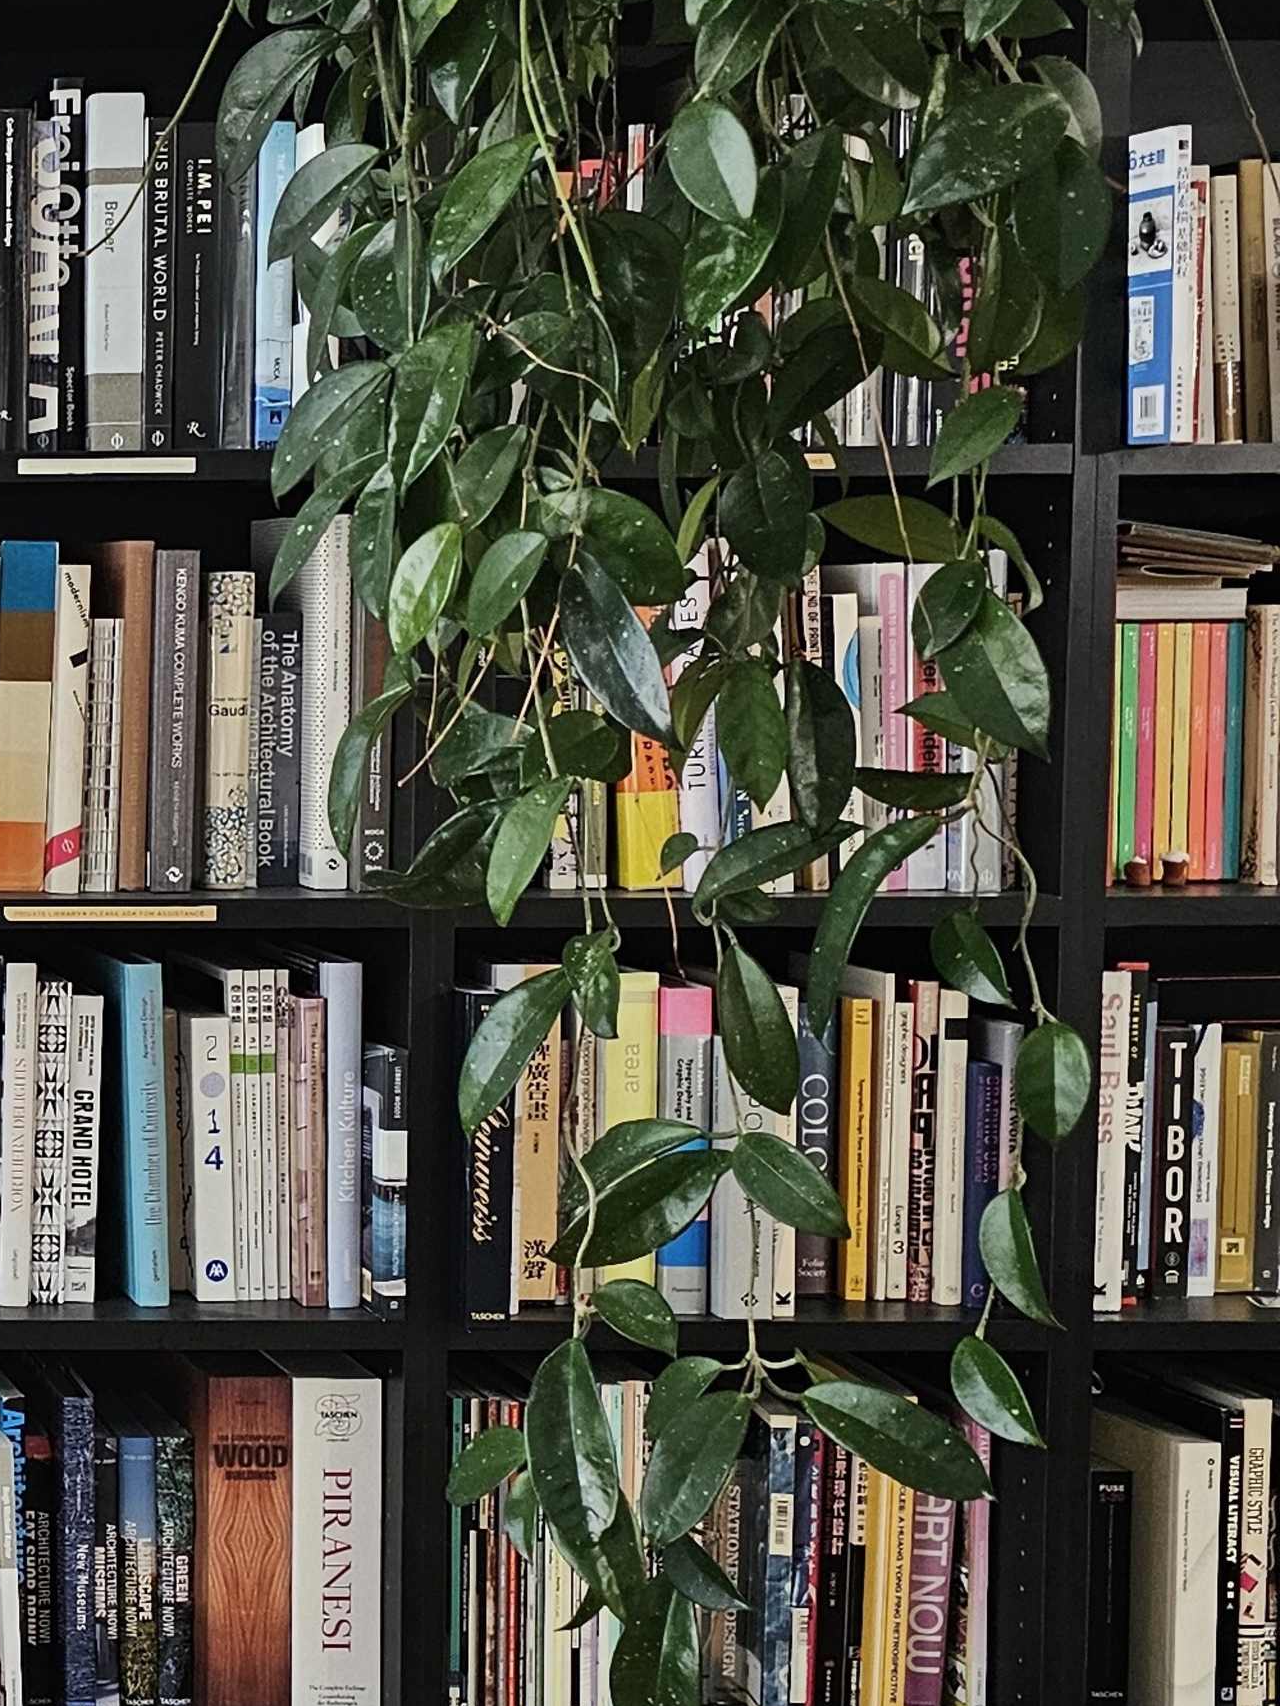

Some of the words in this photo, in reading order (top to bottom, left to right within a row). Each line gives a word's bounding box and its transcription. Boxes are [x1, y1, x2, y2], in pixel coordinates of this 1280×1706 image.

[153, 178, 169, 249] BRUTAL
[153, 254, 169, 322] WORLD
[154, 331, 164, 360] PETER
[153, 363, 164, 415] CHADWICK
[175, 568, 187, 611] KENGO
[807, 590, 818, 607] END
[174, 614, 186, 650] KUMA
[807, 611, 818, 622] OF
[262, 630, 278, 649] of
[282, 630, 298, 666] The
[807, 627, 818, 652] PRINT
[172, 652, 184, 718] COMPLETE
[261, 651, 277, 687] the
[277, 670, 297, 757] Anatomy
[171, 722, 183, 768] WORKS
[258, 692, 277, 814] Architectural
[257, 819, 274, 867] Book
[899, 1011, 909, 1041] graphic
[1099, 993, 1124, 1058] Saul
[1131, 994, 1140, 1013] THE
[1130, 1017, 1140, 1043] BEST
[1131, 1046, 1139, 1058] OF
[580, 1034, 593, 1075] Mapping
[624, 1041, 641, 1094] area
[674, 1058, 685, 1093] Graphic
[898, 1044, 909, 1084] designers
[338, 1071, 356, 1132] Kulture
[580, 1077, 592, 1109] graphic
[684, 1058, 695, 1102] Typography
[72, 1089, 95, 1149] GRAND
[674, 1095, 685, 1119] Design
[684, 1104, 694, 1120] and
[1098, 1072, 1121, 1143] Bass
[1164, 1042, 1187, 1243] TIBOR
[71, 1155, 92, 1209] HOTEL
[338, 1136, 356, 1202] Kitchen
[893, 1205, 903, 1234] Europe
[801, 1259, 826, 1268] Folio
[893, 1241, 905, 1254] 3
[798, 1269, 827, 1278] Society
[212, 1444, 288, 1469] WOOD
[1226, 1455, 1241, 1501] VISUAL
[1248, 1447, 1264, 1496] GRAPHIC
[914, 1492, 953, 1566] ART
[1225, 1505, 1240, 1563] LITERACY
[1247, 1500, 1263, 1534] STYLE
[38, 1512, 50, 1605] ARCHITECTURE
[106, 1524, 118, 1607] ARCHITECTURE
[125, 1520, 137, 1609] ARCHITECTURE
[162, 1520, 174, 1609] ARCHITECTURE
[322, 1468, 352, 1652] PIRANESI
[895, 1525, 904, 1563] HUANG
[176, 1555, 188, 1602] GREEN
[894, 1564, 903, 1593] YONG
[75, 1574, 89, 1631] Museums
[106, 1610, 117, 1640] NOW!
[893, 1596, 902, 1620] PING
[906, 1575, 946, 1673] NOW
[722, 1609, 737, 1678] DESIGN
[890, 1622, 901, 1703] RETROSPECTIVE
